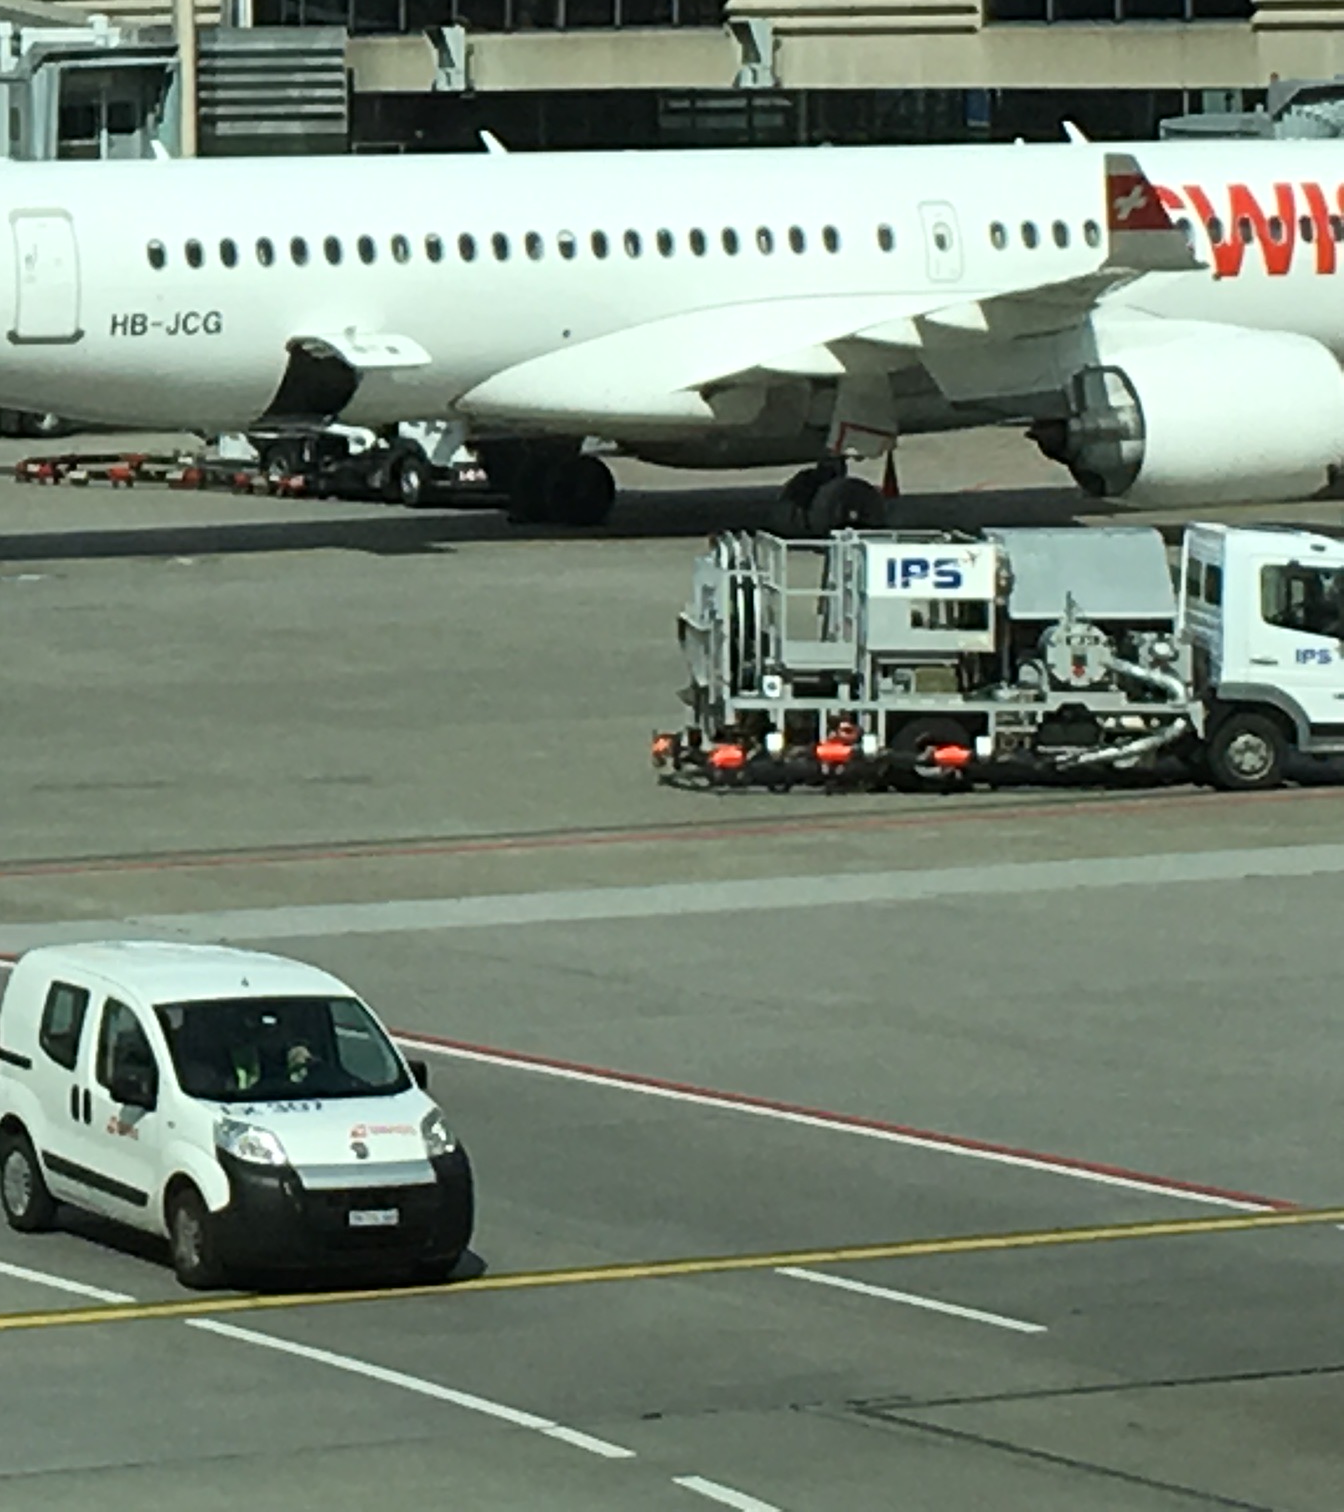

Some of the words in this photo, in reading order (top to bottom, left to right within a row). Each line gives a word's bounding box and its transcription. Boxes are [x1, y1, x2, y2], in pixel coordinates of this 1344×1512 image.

[1153, 182, 1344, 277] WI
[110, 310, 223, 336] HB-JCG
[887, 557, 962, 589] IPS
[1296, 649, 1332, 664] IPS
